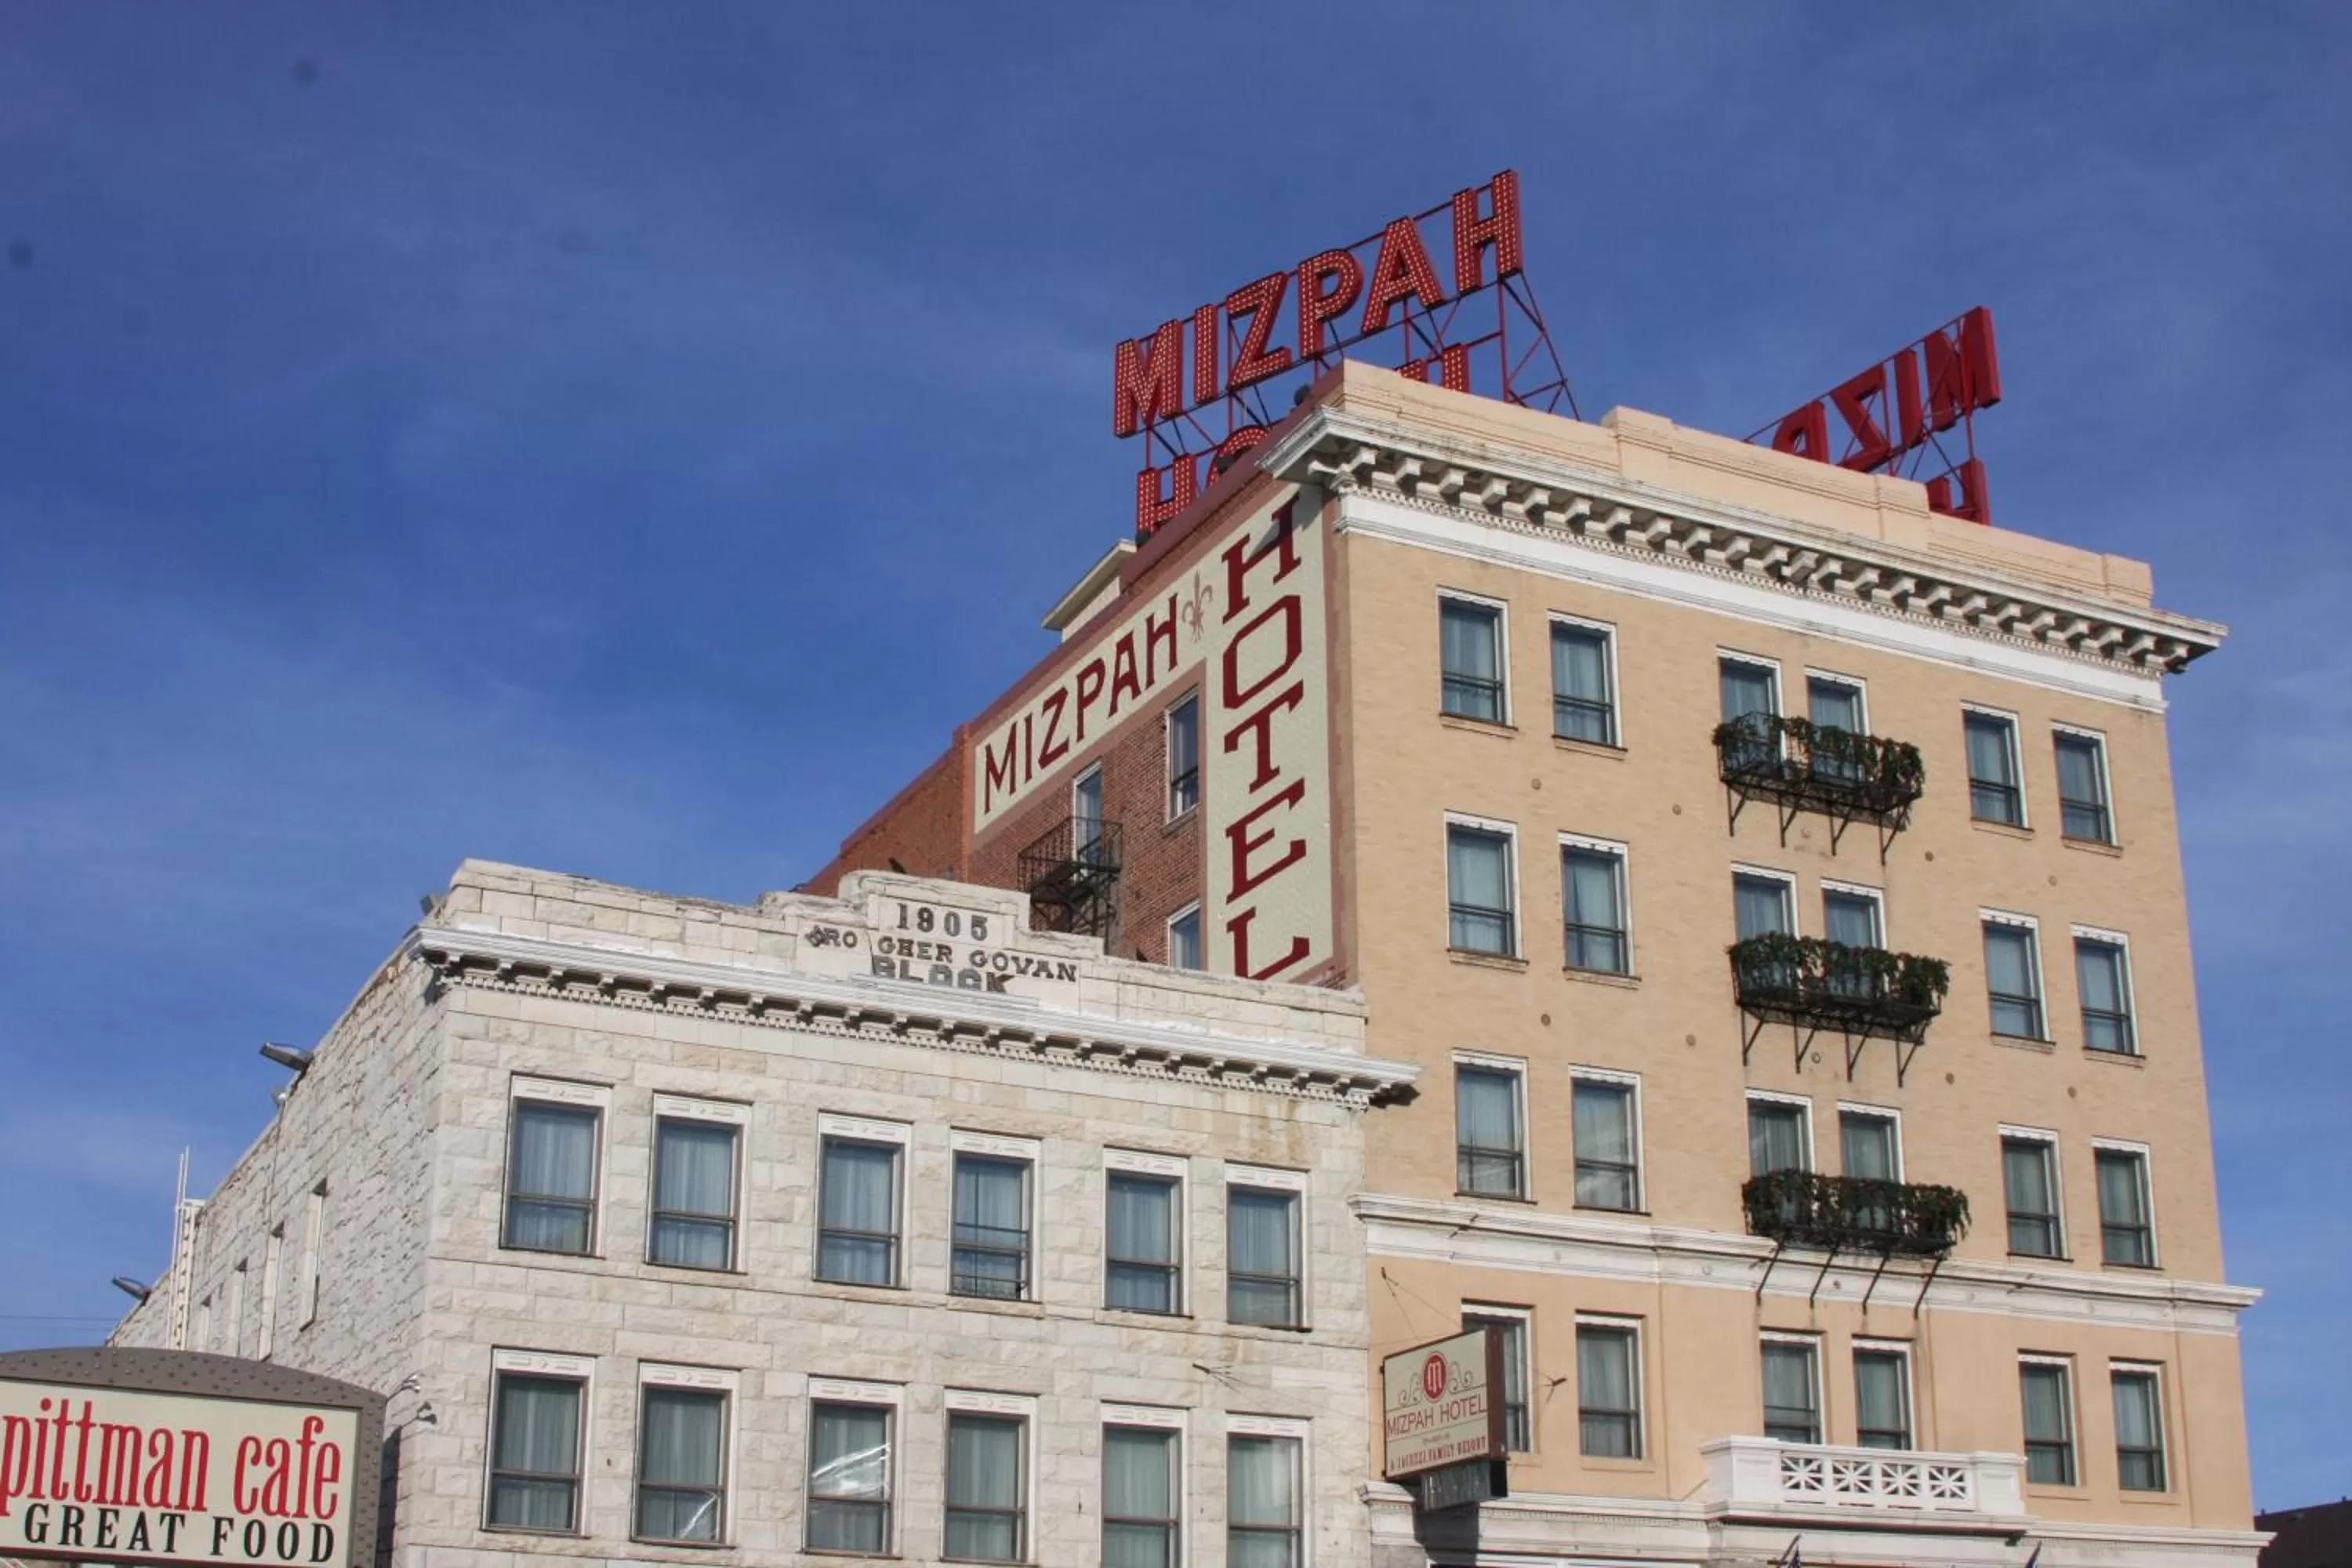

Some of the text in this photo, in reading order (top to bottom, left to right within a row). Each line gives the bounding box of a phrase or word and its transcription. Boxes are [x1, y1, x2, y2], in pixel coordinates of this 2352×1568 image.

[1115, 169, 1523, 437] MIZPAH
[984, 593, 1178, 815] MIZPAH
[1221, 492, 1310, 981] HOTEL
[896, 902, 988, 942] 1905
[969, 949, 1076, 982] GOVAN
[0, 1398, 341, 1520] pittman cafe
[1386, 1396, 1487, 1437] MIZPAH HOTEL
[24, 1503, 335, 1563] GREAT FOOD
